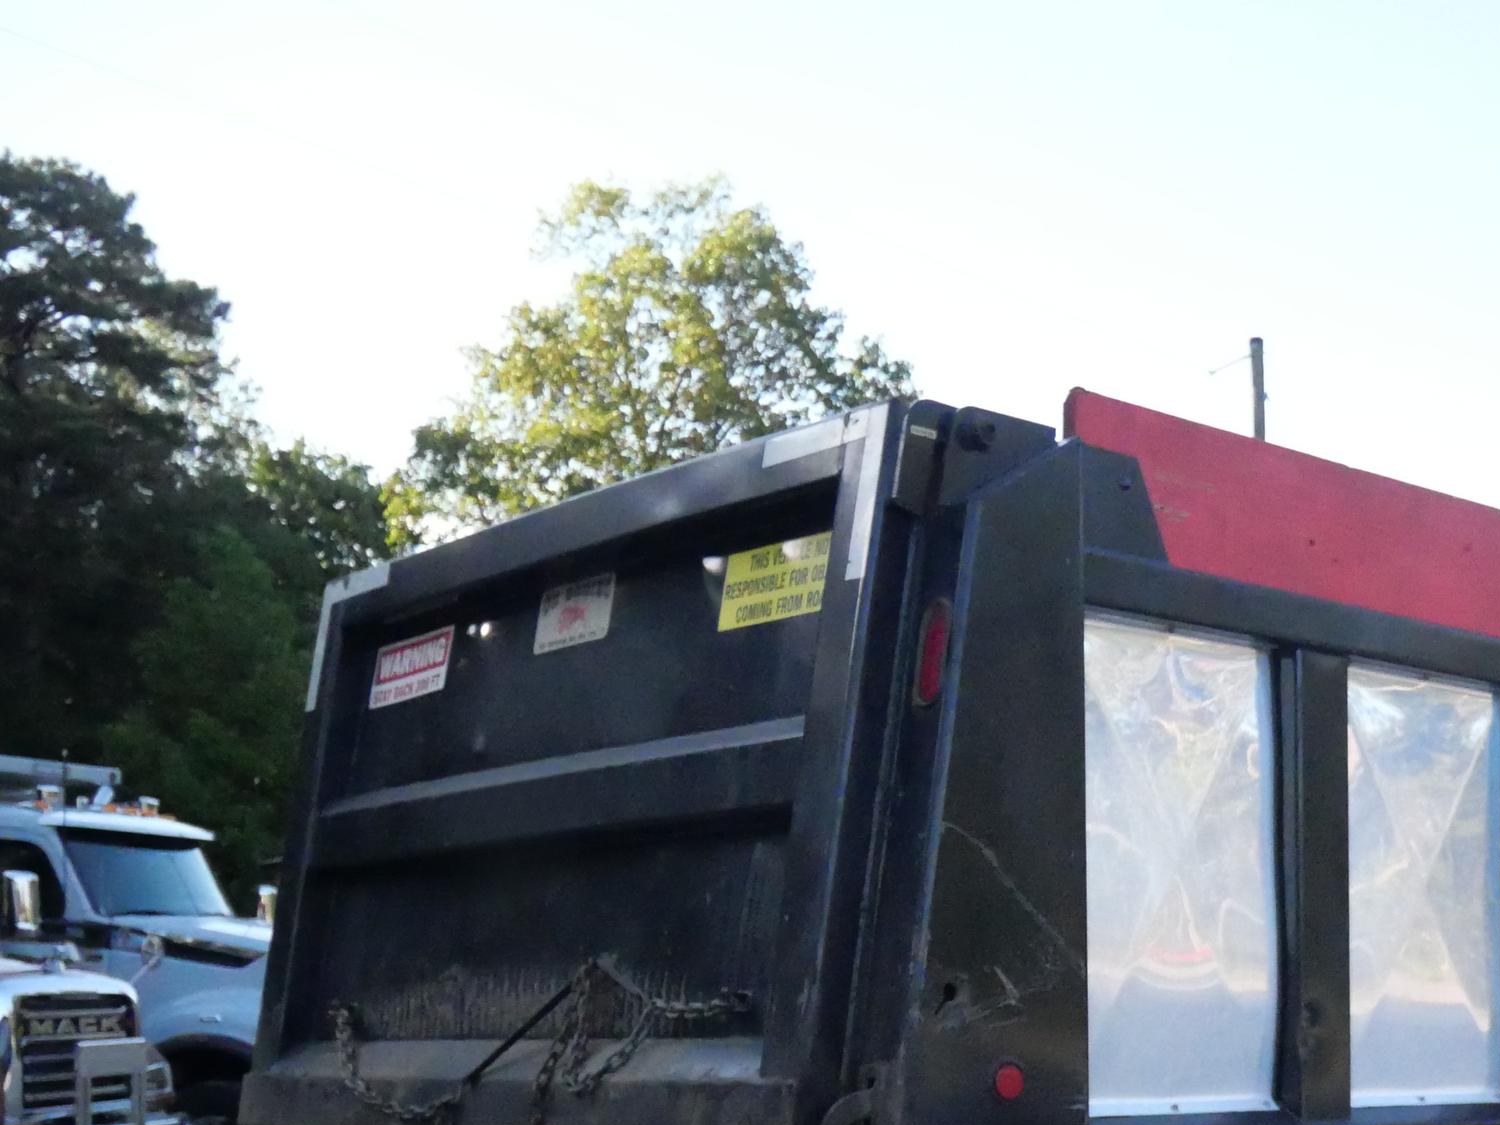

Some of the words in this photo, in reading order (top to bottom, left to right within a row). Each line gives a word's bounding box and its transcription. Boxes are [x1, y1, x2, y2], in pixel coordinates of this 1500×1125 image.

[751, 552, 769, 572] THIS
[725, 571, 786, 600] RESPONSIBLE
[789, 568, 808, 587] FOR
[736, 600, 773, 623] COMING
[776, 593, 803, 614] FROM
[380, 637, 446, 680] WARNING
[29, 1015, 123, 1035] MACK
